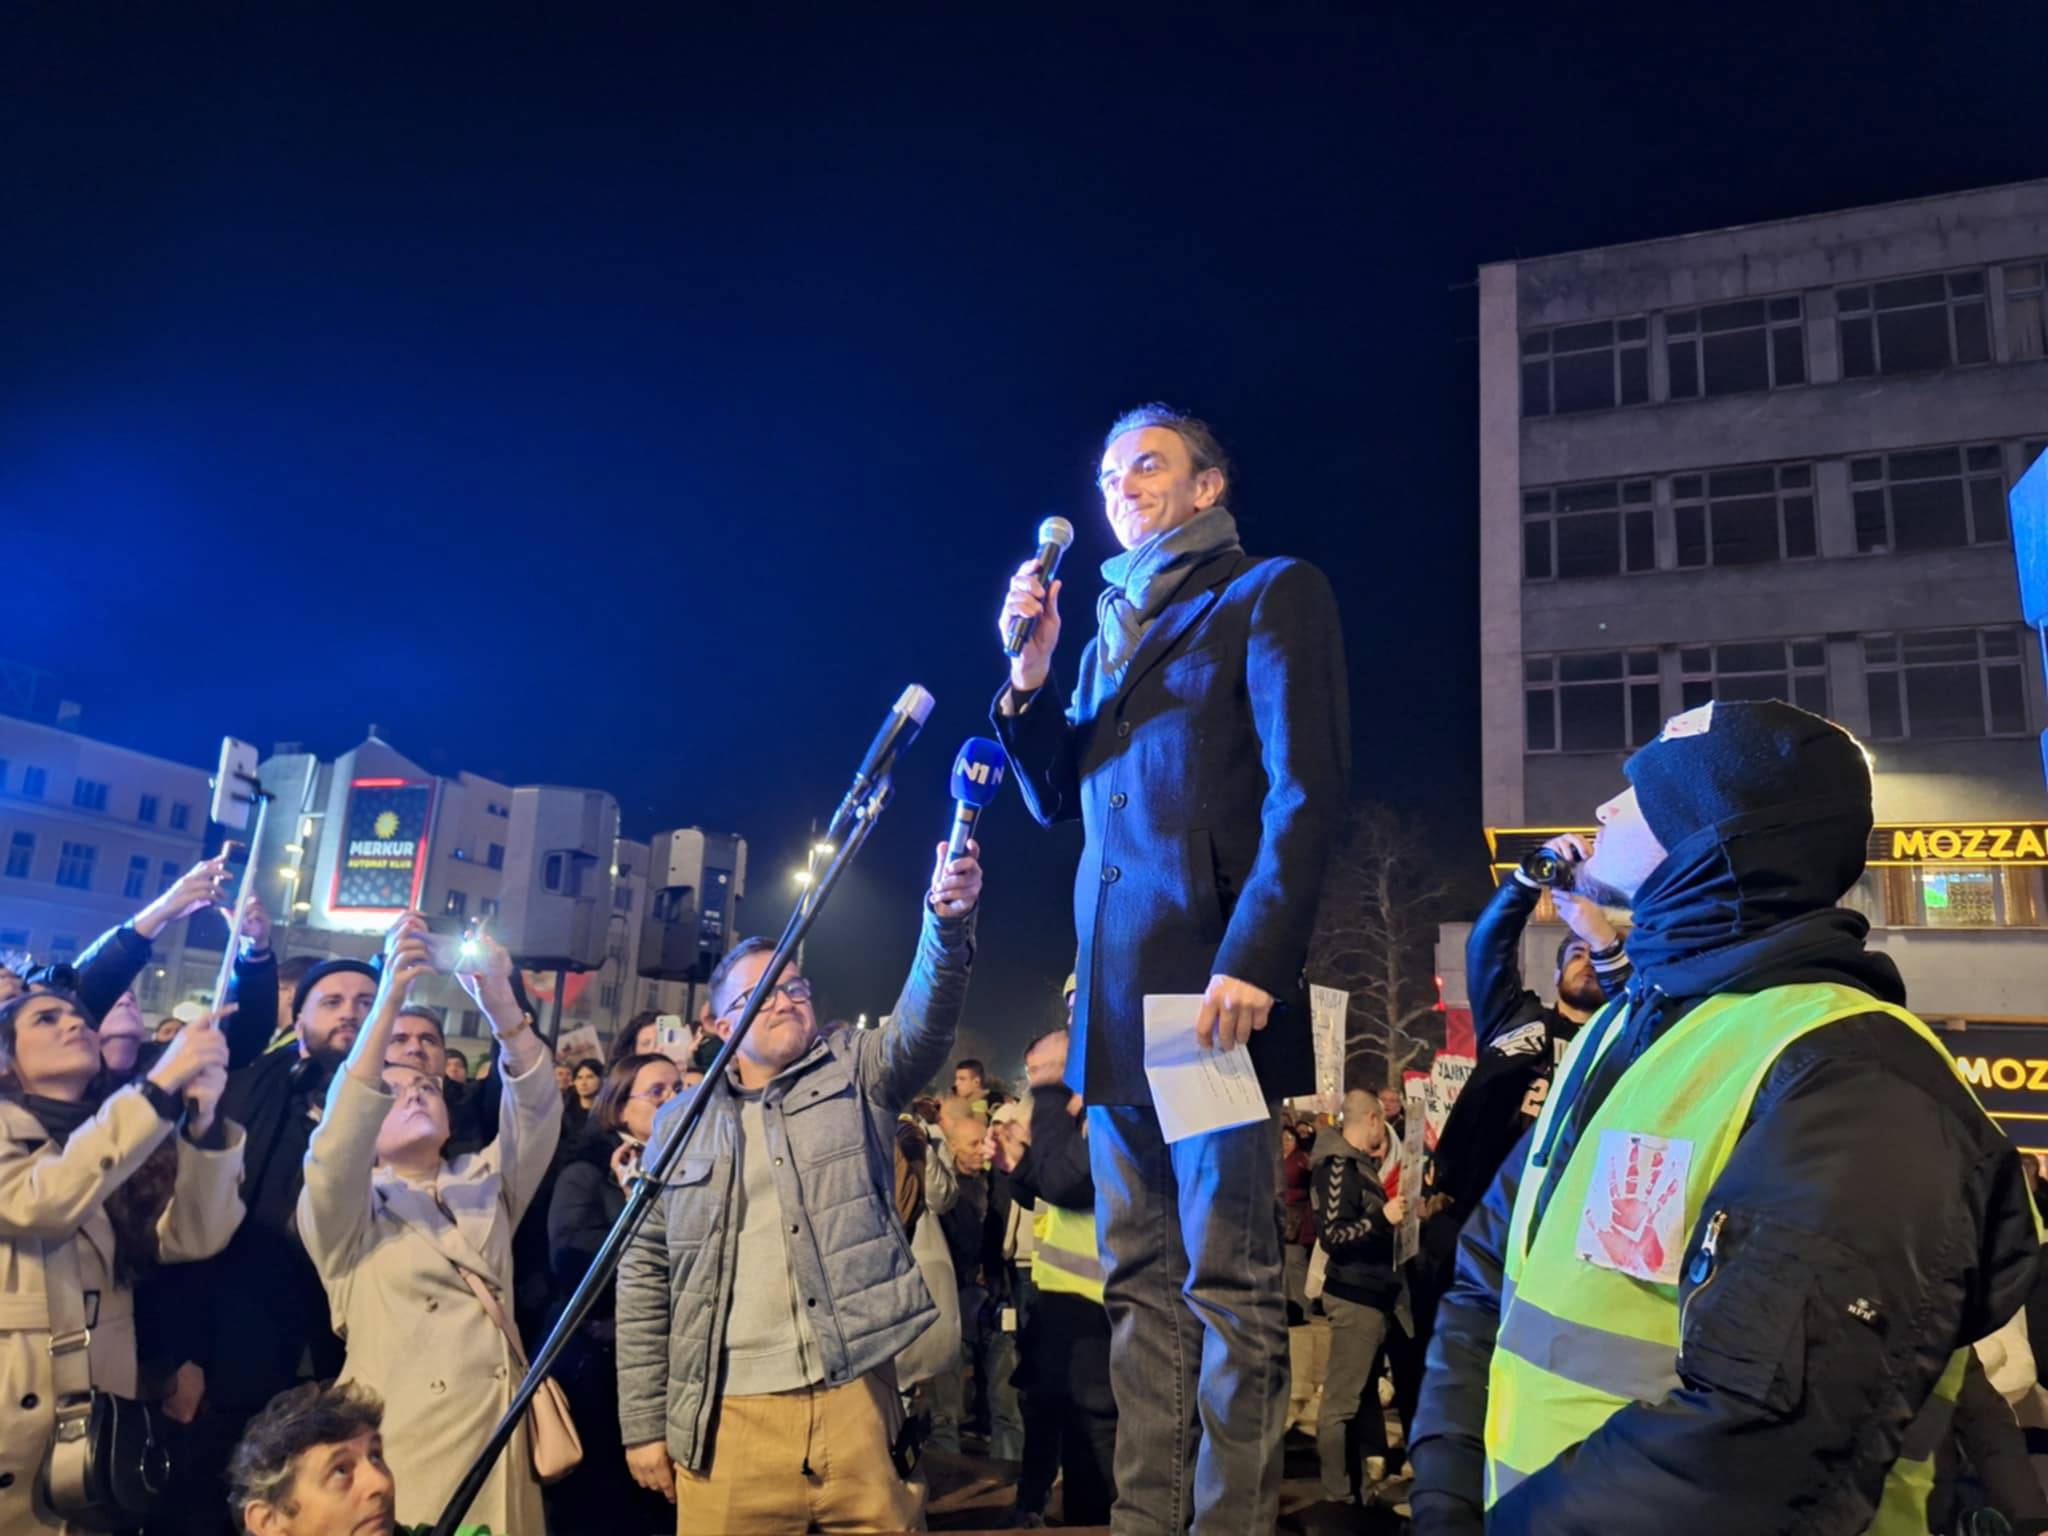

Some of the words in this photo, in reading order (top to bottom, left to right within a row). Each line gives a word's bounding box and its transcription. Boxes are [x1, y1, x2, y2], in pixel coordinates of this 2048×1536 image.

[956, 757, 990, 785] N1
[349, 841, 415, 856] MERKUR
[1893, 829, 2048, 858] MOZZA
[347, 858, 388, 868] AUTOMAT
